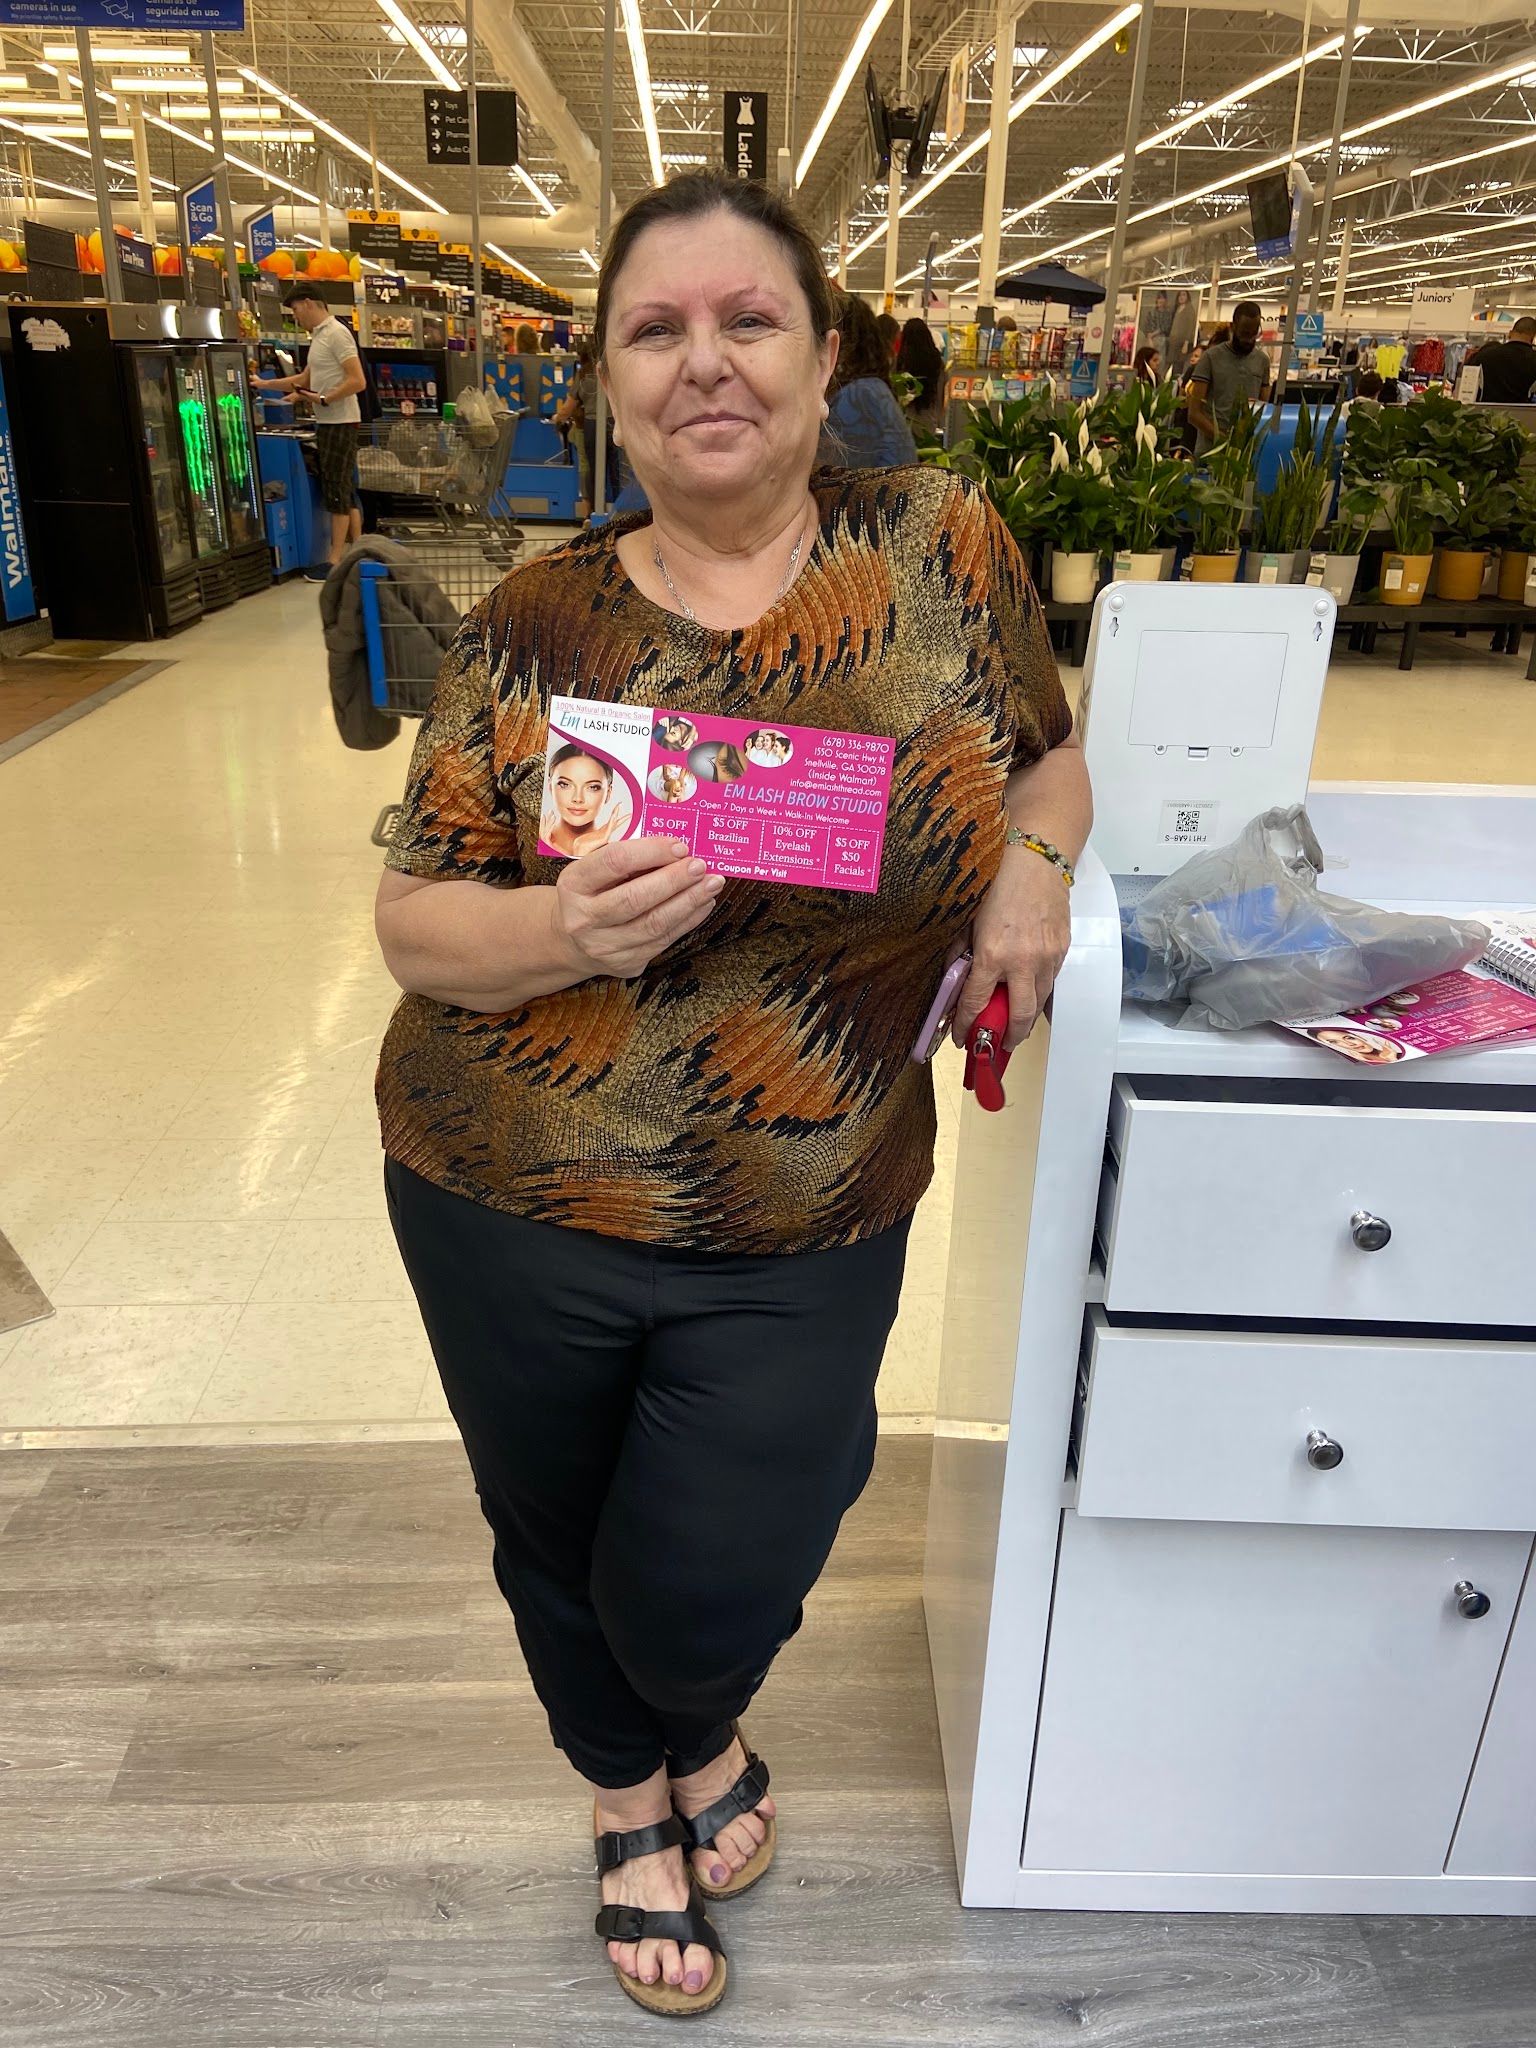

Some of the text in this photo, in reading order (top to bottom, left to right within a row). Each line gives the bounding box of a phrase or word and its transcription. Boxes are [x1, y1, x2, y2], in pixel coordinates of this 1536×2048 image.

[10, 3, 48, 11] cameras
[50, 3, 59, 11] in
[145, 7, 189, 17] seguridad
[738, 132, 753, 178] Ladie
[190, 202, 213, 213] Scan
[253, 229, 273, 239] Scan
[1417, 291, 1455, 303] Juniors'
[583, 719, 609, 732] LASH
[612, 723, 651, 737] STUDIO
[823, 736, 890, 753] (678) 336-9870
[814, 747, 833, 758] 1550
[835, 750, 860, 761] Scenic
[861, 753, 877, 765] Hwy
[841, 762, 855, 772] GA
[857, 764, 887, 776] 30078
[808, 769, 877, 786] (Inside Walmart)
[790, 778, 882, 797] info@emlashthread.com
[723, 783, 883, 815] EM LASH BROW STUDIO
[699, 799, 722, 810] Open
[723, 802, 729, 810] 7
[730, 803, 747, 814] Days
[756, 806, 777, 816] Week
[785, 809, 813, 821] Walk-Ins
[815, 813, 850, 825] Welcome
[651, 816, 688, 831] $5 OFF
[712, 816, 749, 830] $5 OFF
[707, 830, 750, 844] Brazilian
[772, 825, 817, 839] 10% OFF
[713, 844, 735, 855] Wax
[775, 839, 811, 852] Eyelash
[834, 837, 871, 850] $5 OFF
[763, 851, 814, 866] Extensions
[841, 851, 860, 863] $50
[717, 862, 752, 874] Coupon
[753, 866, 769, 876] Per
[770, 867, 788, 878] Visit
[834, 864, 865, 877] Facials
